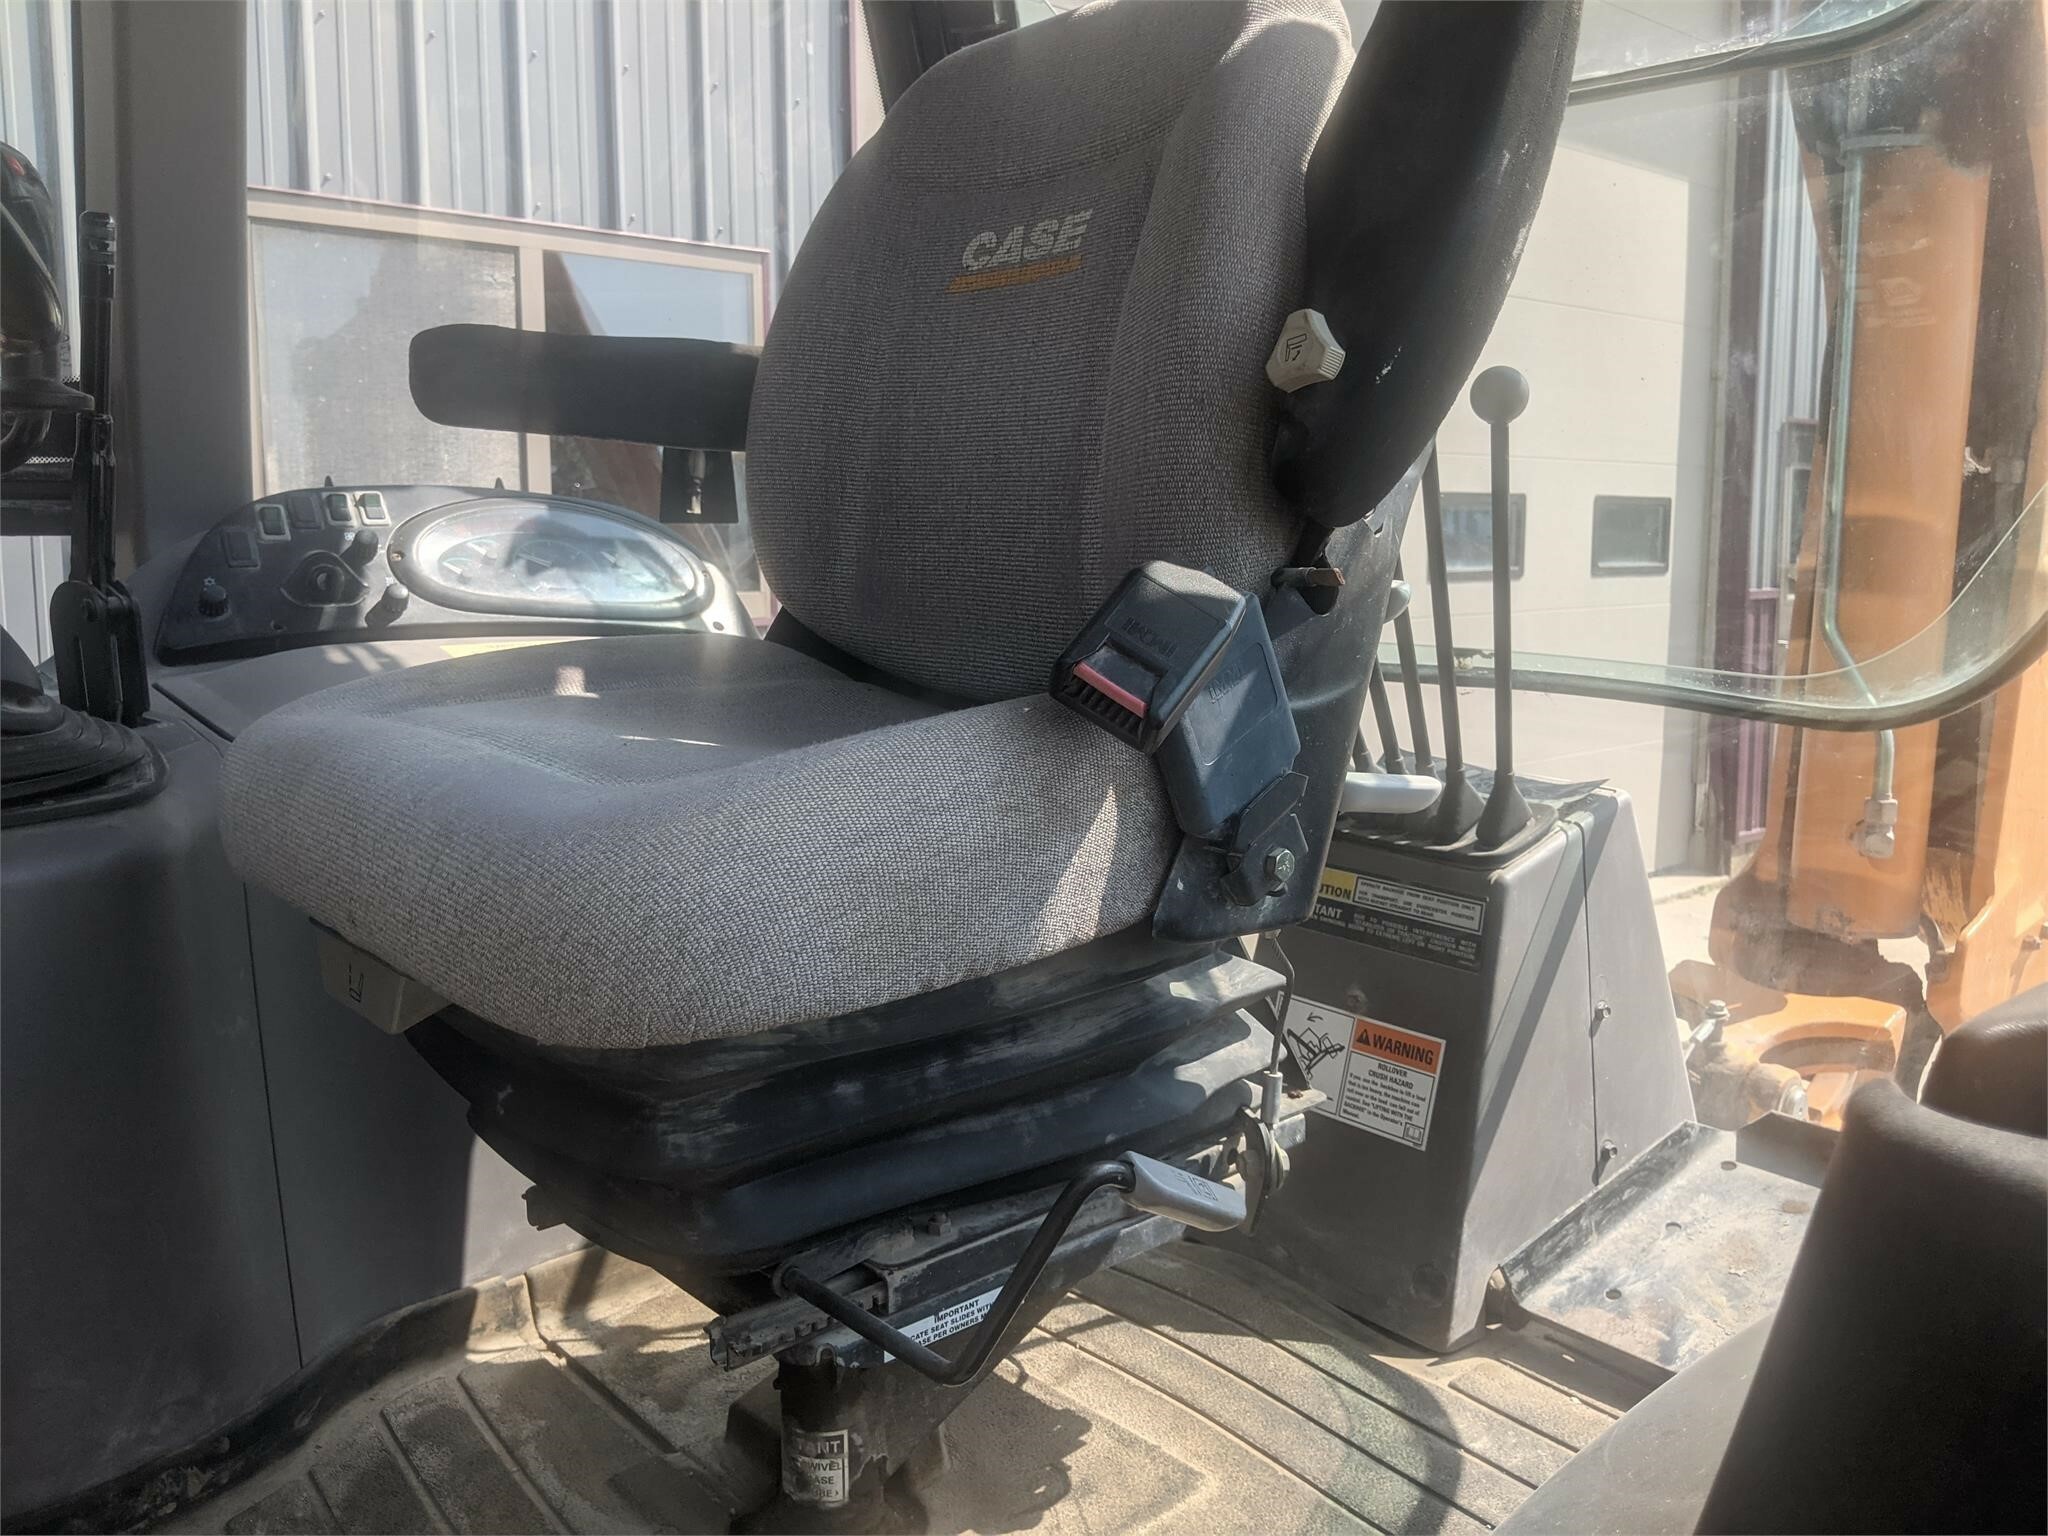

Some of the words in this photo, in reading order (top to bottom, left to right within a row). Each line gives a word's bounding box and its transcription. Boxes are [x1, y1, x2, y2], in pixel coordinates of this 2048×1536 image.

[962, 208, 1093, 271] CASE
[1319, 884, 1352, 900] UTION
[1314, 903, 1343, 919] TANT
[1373, 1033, 1434, 1065] WARNING
[1368, 1069, 1388, 1080] CRUSH
[1389, 1076, 1414, 1089] HAZARD
[1378, 1062, 1408, 1077] ROLLOVER
[934, 1299, 980, 1323] IMPORTANT
[911, 1329, 929, 1341] CATE
[930, 1321, 949, 1333] SEAT
[950, 1309, 975, 1324] SLIDES
[918, 1336, 932, 1345] ASE
[933, 1329, 948, 1340] PER
[949, 1315, 979, 1332] OWNERS
[810, 1461, 842, 1471] WIVEL
